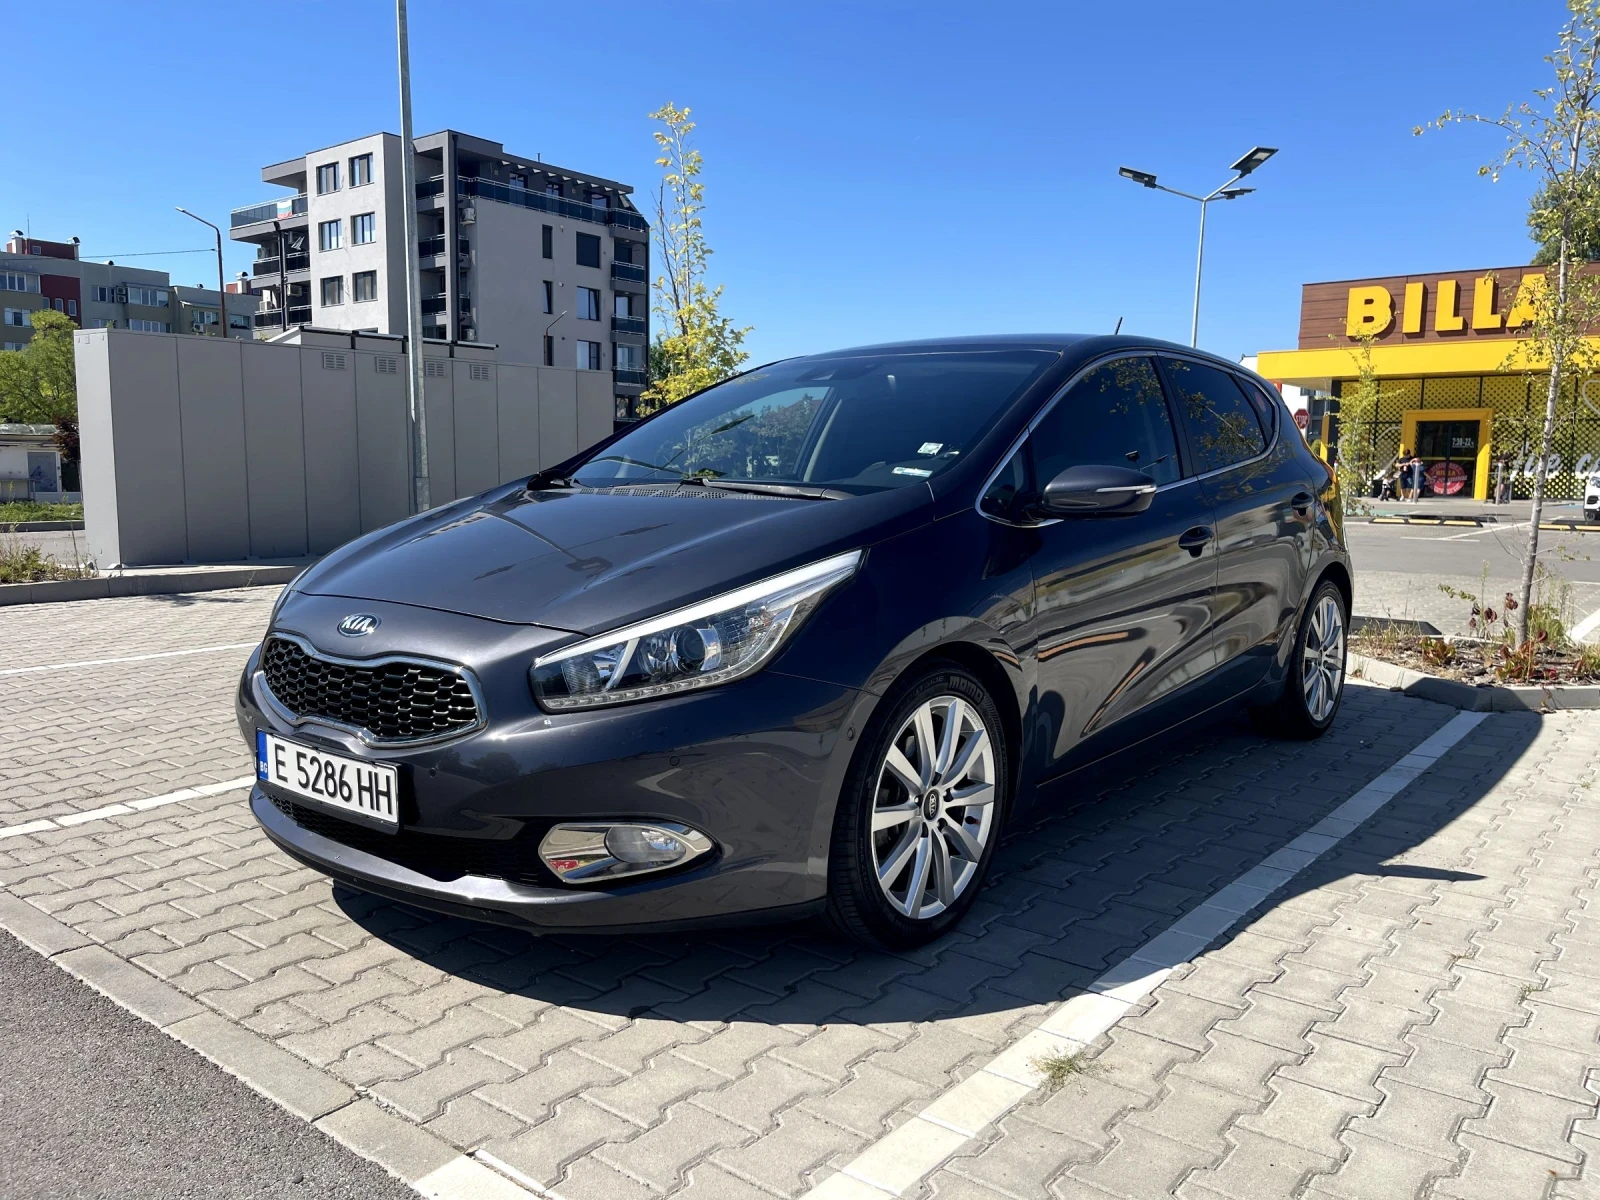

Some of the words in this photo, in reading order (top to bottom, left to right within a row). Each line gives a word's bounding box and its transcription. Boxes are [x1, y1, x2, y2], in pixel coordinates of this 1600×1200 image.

[1346, 273, 1553, 337] BILLA
[340, 614, 375, 633] KIA
[949, 675, 984, 703] MOMO
[259, 760, 268, 773] BG
[274, 743, 288, 783] E
[296, 750, 353, 803] 5286
